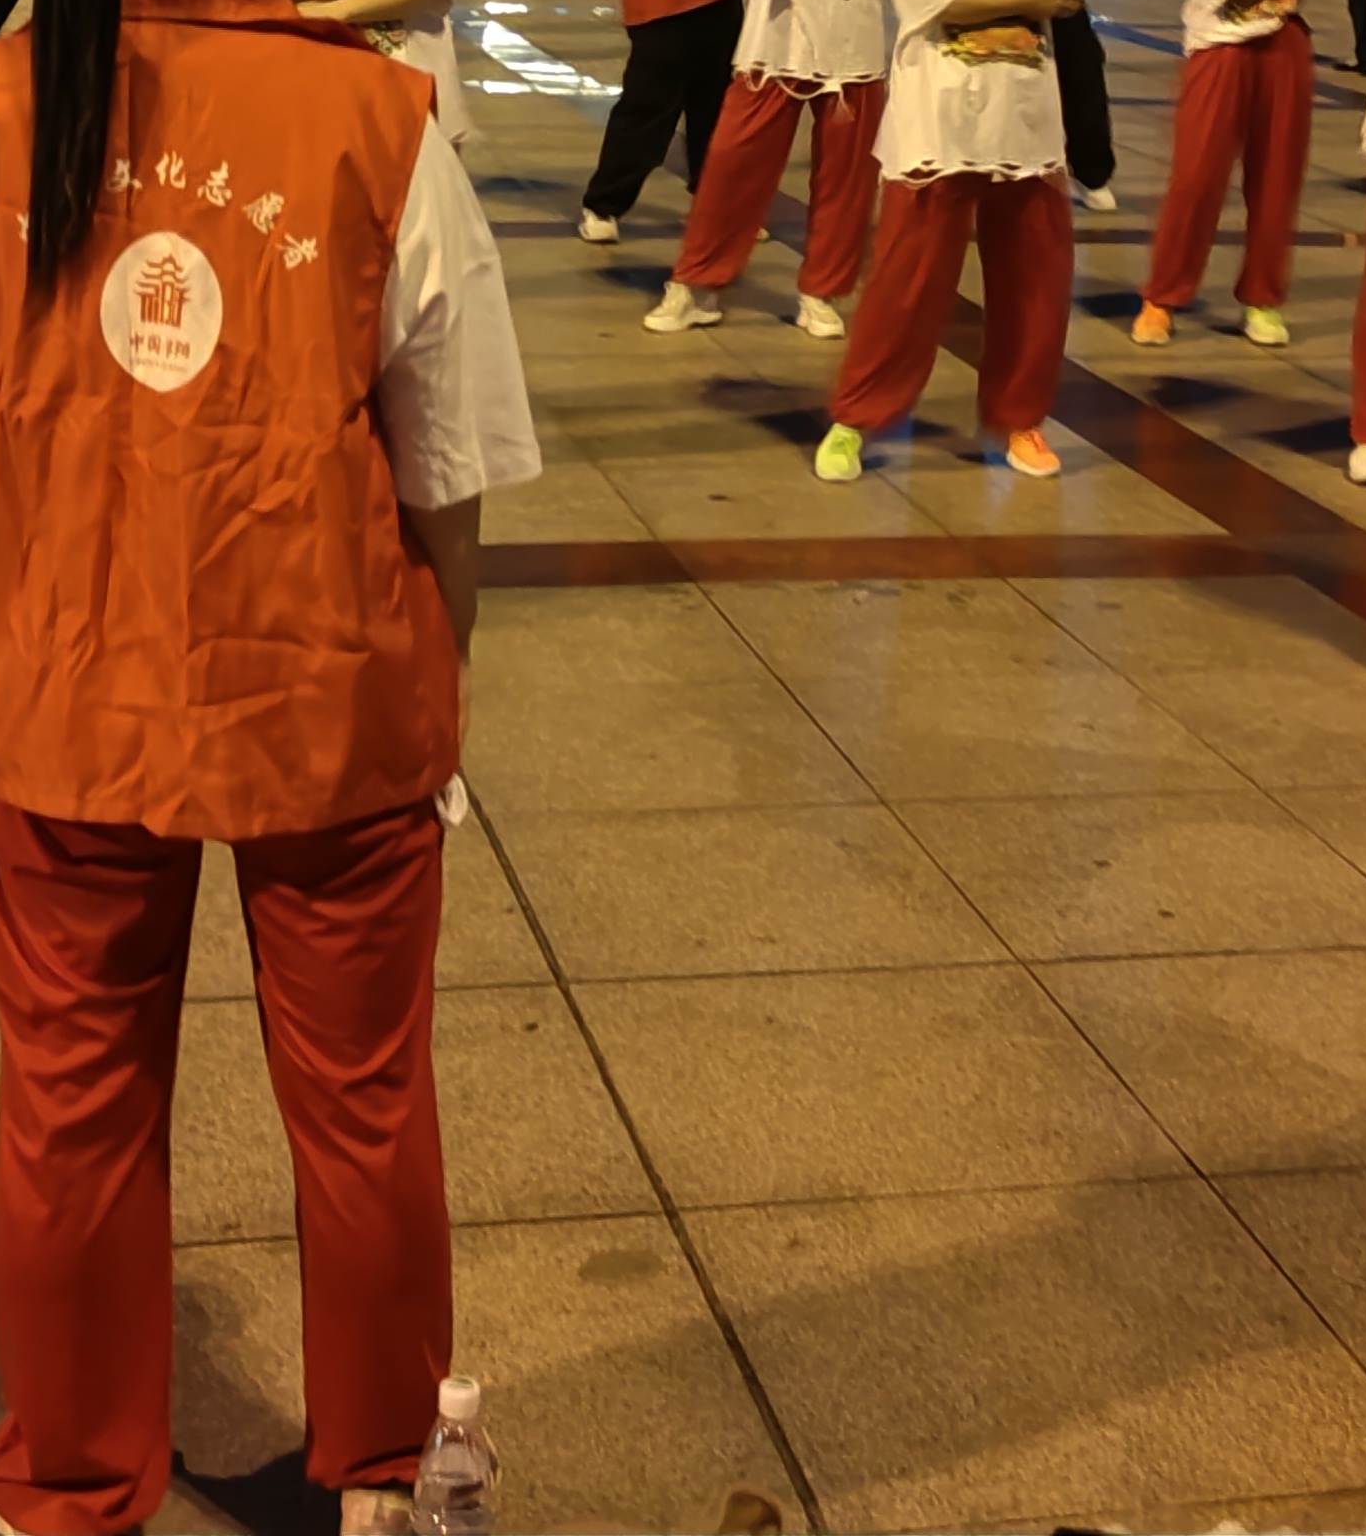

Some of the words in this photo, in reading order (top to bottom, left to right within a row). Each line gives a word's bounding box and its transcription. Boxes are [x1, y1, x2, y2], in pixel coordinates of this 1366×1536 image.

[16, 150, 318, 269] 文化志愿者
